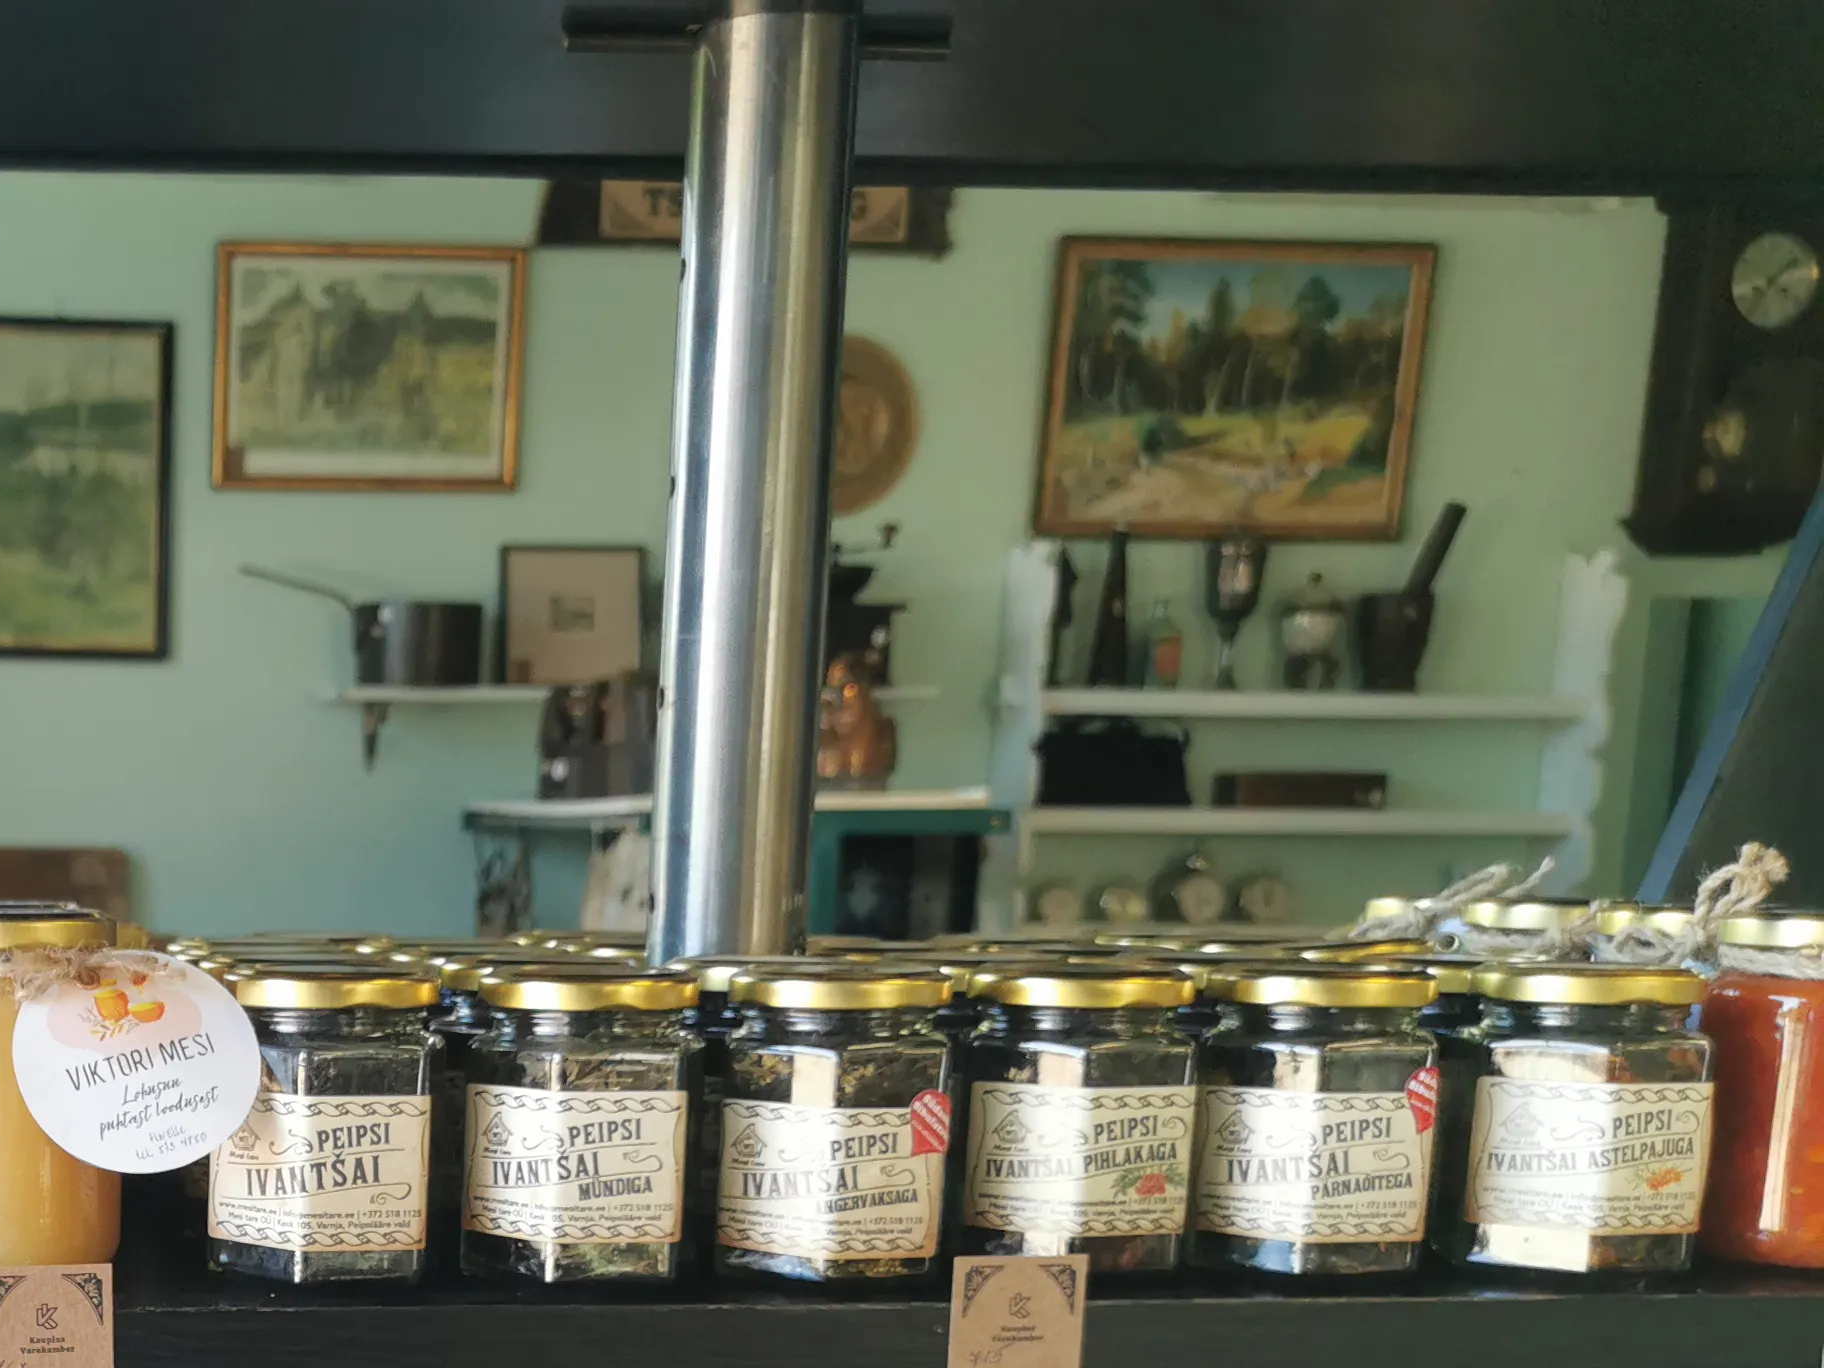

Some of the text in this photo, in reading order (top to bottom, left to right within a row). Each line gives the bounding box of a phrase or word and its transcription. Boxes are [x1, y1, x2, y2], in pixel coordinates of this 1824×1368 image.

[65, 1032, 215, 1091] VIKTORI MESI
[99, 1086, 219, 1141] puhtast loodusest
[1611, 1109, 1673, 1139] PEIPSI
[315, 1122, 390, 1152] PEIPSI
[567, 1118, 642, 1148] PEIPSI
[1093, 1115, 1158, 1144] PEIPSI
[1321, 1116, 1392, 1145] PEIPSI
[830, 1132, 899, 1161] PEIPSI
[1082, 1142, 1177, 1174] PIHLAKAGA
[1487, 1137, 1694, 1172] IVANTŠAI ASTELPAJUGA
[246, 1151, 381, 1197] IVANTŠAI
[492, 1149, 600, 1186] IVANTŠAI
[1227, 1148, 1350, 1184] IVANTŠAI
[362, 1210, 383, 1219] +372
[403, 1209, 422, 1218] 1125
[815, 1188, 918, 1215] ANGERVAKSAGA
[19, 1345, 75, 1355] Varakamber
[29, 1336, 65, 1345] Kauplus
